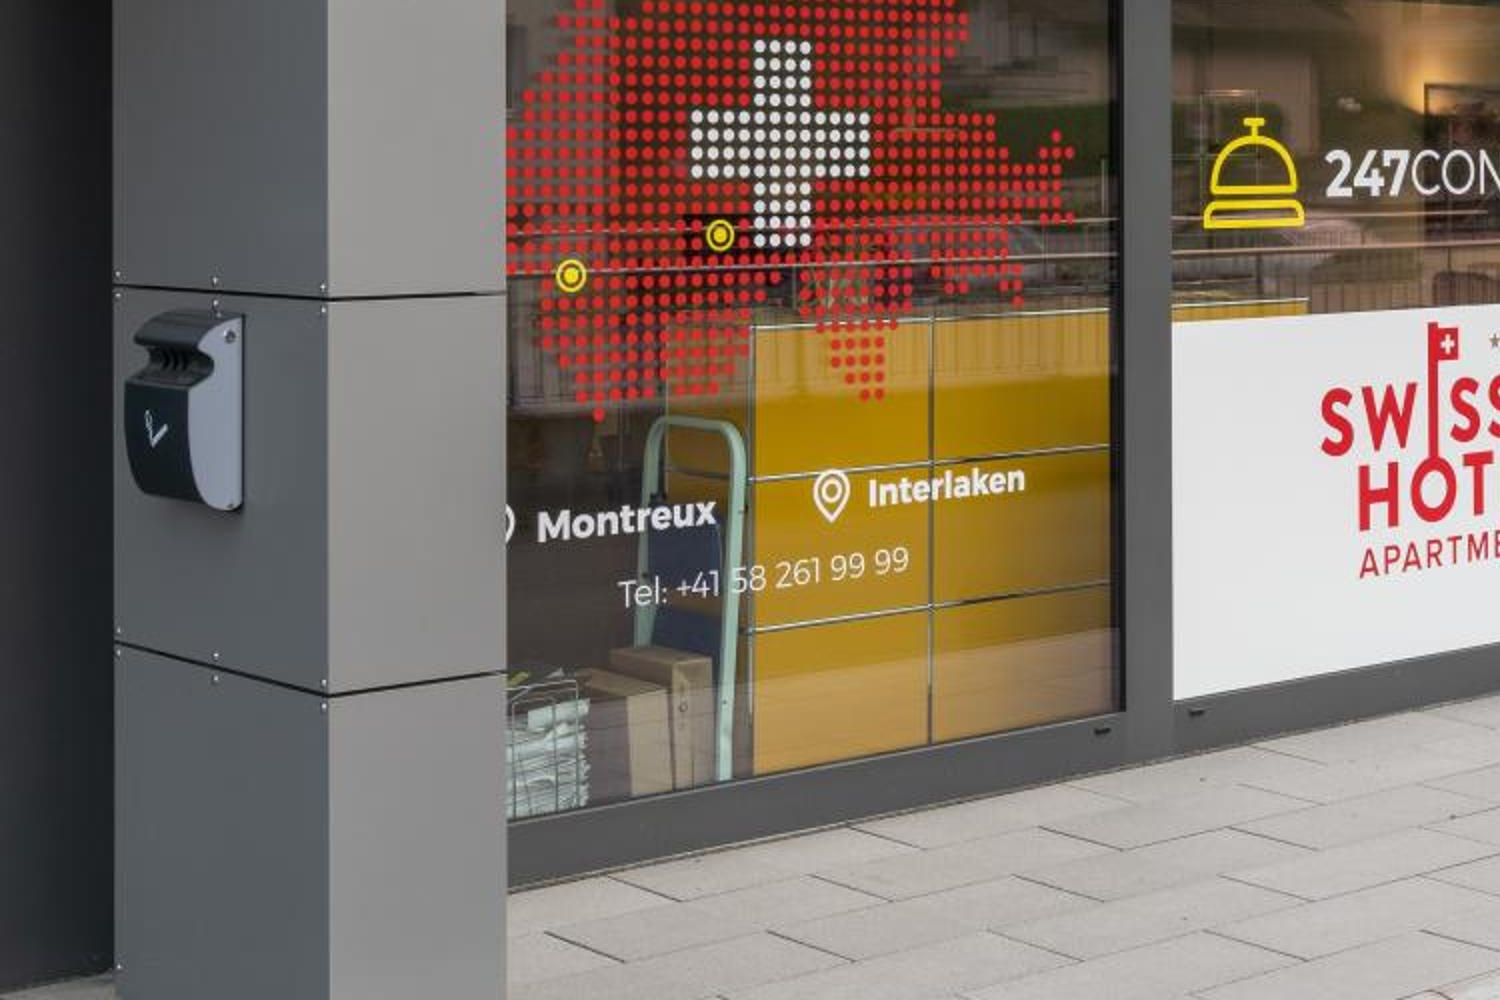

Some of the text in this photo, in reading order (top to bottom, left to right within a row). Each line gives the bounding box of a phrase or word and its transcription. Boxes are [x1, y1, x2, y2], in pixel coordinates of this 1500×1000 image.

[868, 467, 1026, 509] Interlaken
[536, 499, 719, 543] Montreux
[617, 546, 910, 609] Tel: +41 58 261 99 99
